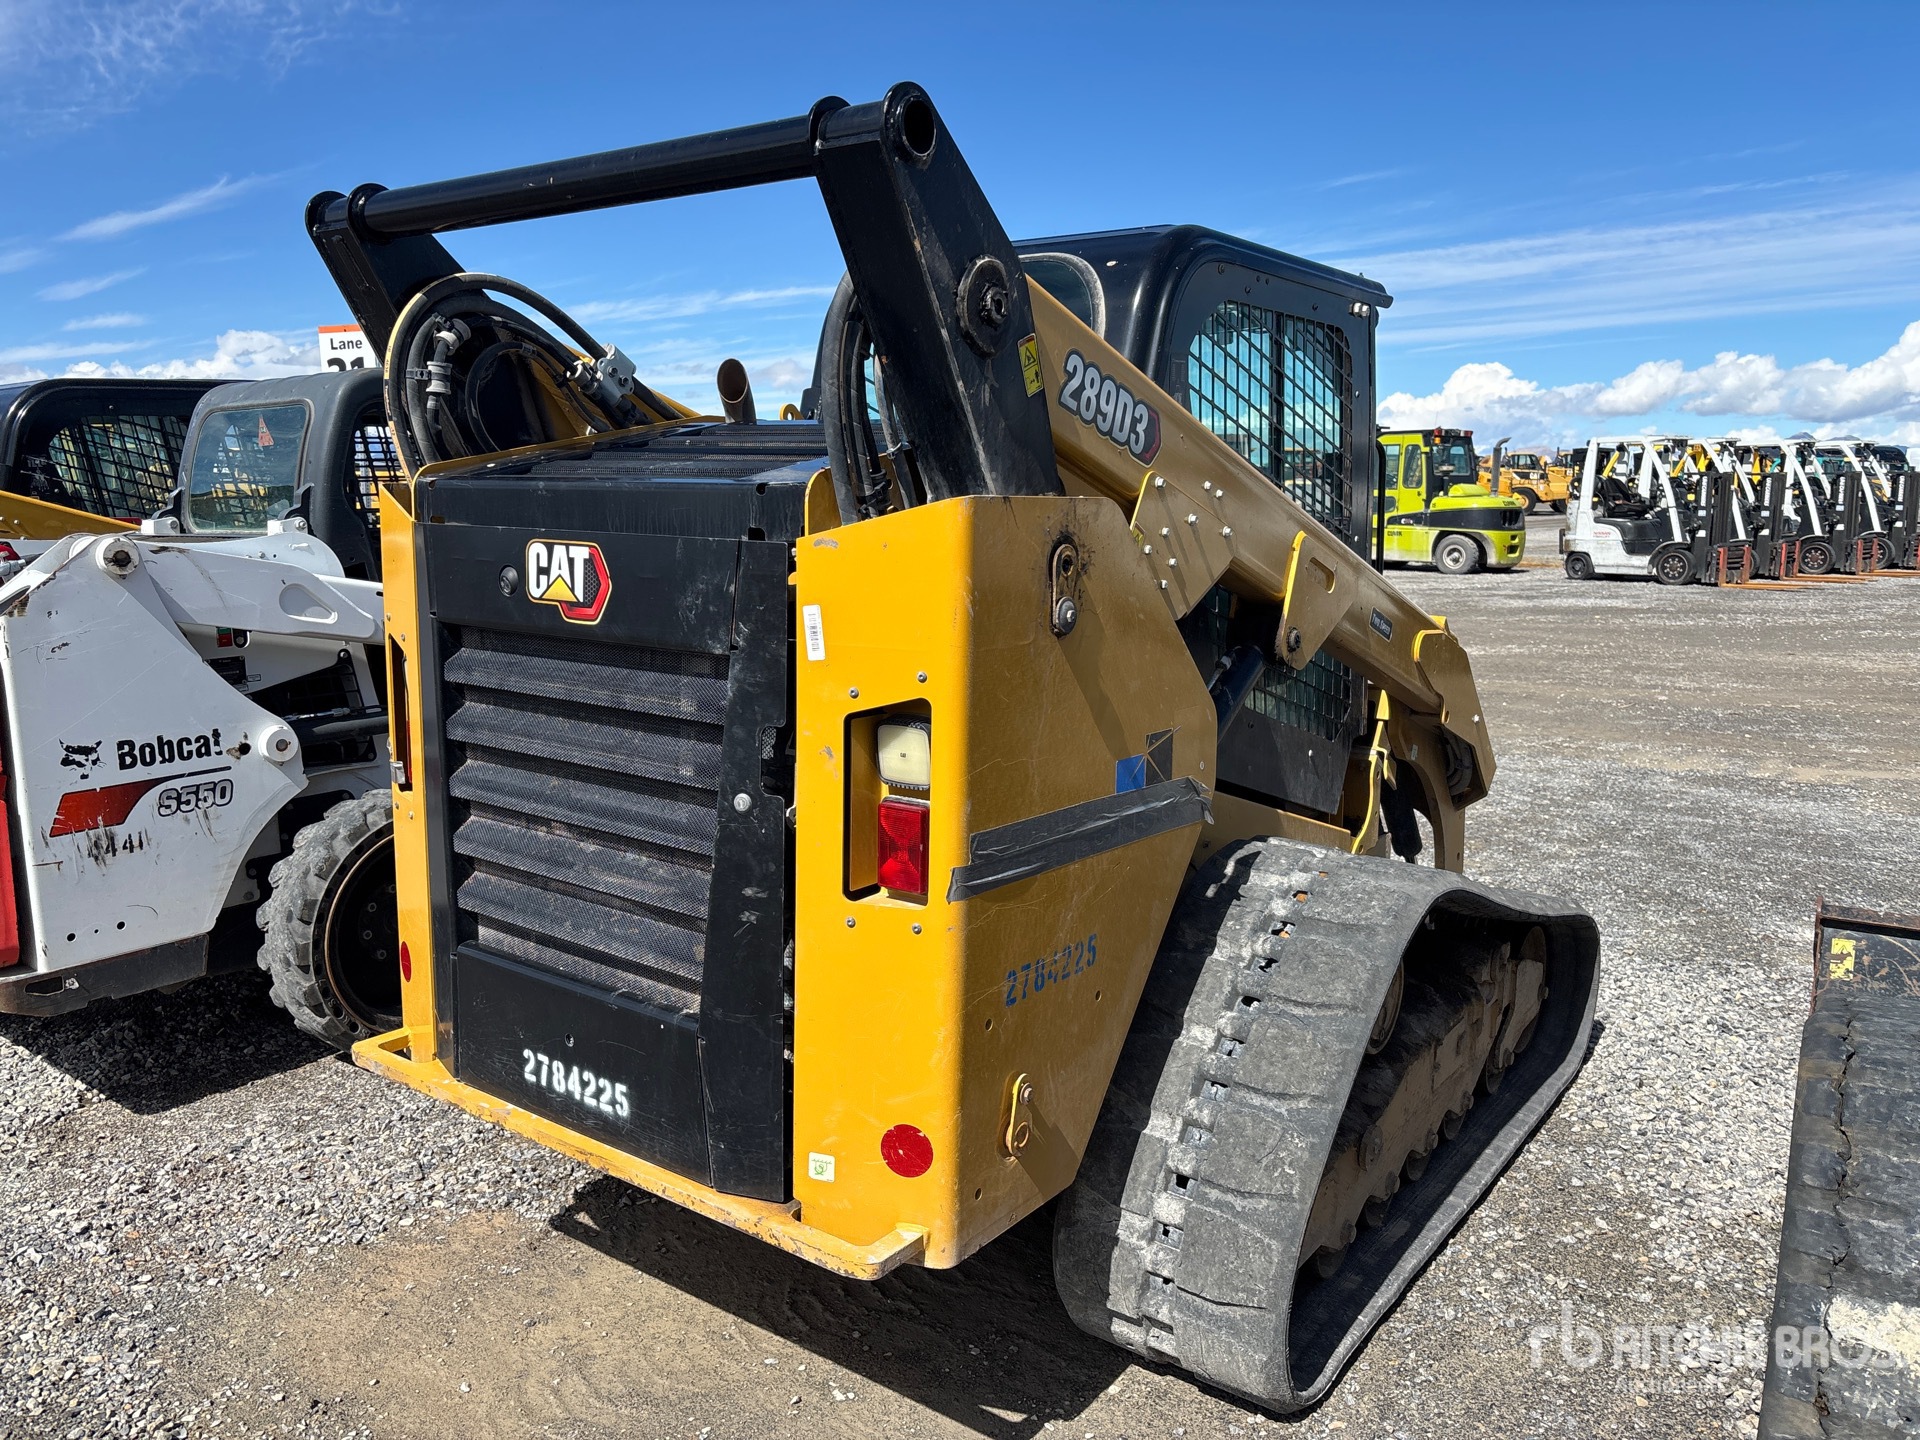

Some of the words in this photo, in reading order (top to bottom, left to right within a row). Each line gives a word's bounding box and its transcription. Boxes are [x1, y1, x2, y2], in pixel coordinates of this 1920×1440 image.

[330, 337, 363, 350] Lane
[1059, 352, 1149, 455] 289D3
[528, 541, 590, 603] CAT
[116, 728, 225, 771] Bobcat
[157, 778, 234, 818] S550
[1005, 933, 1098, 1008] 2784225
[522, 1048, 630, 1117] 2784225
